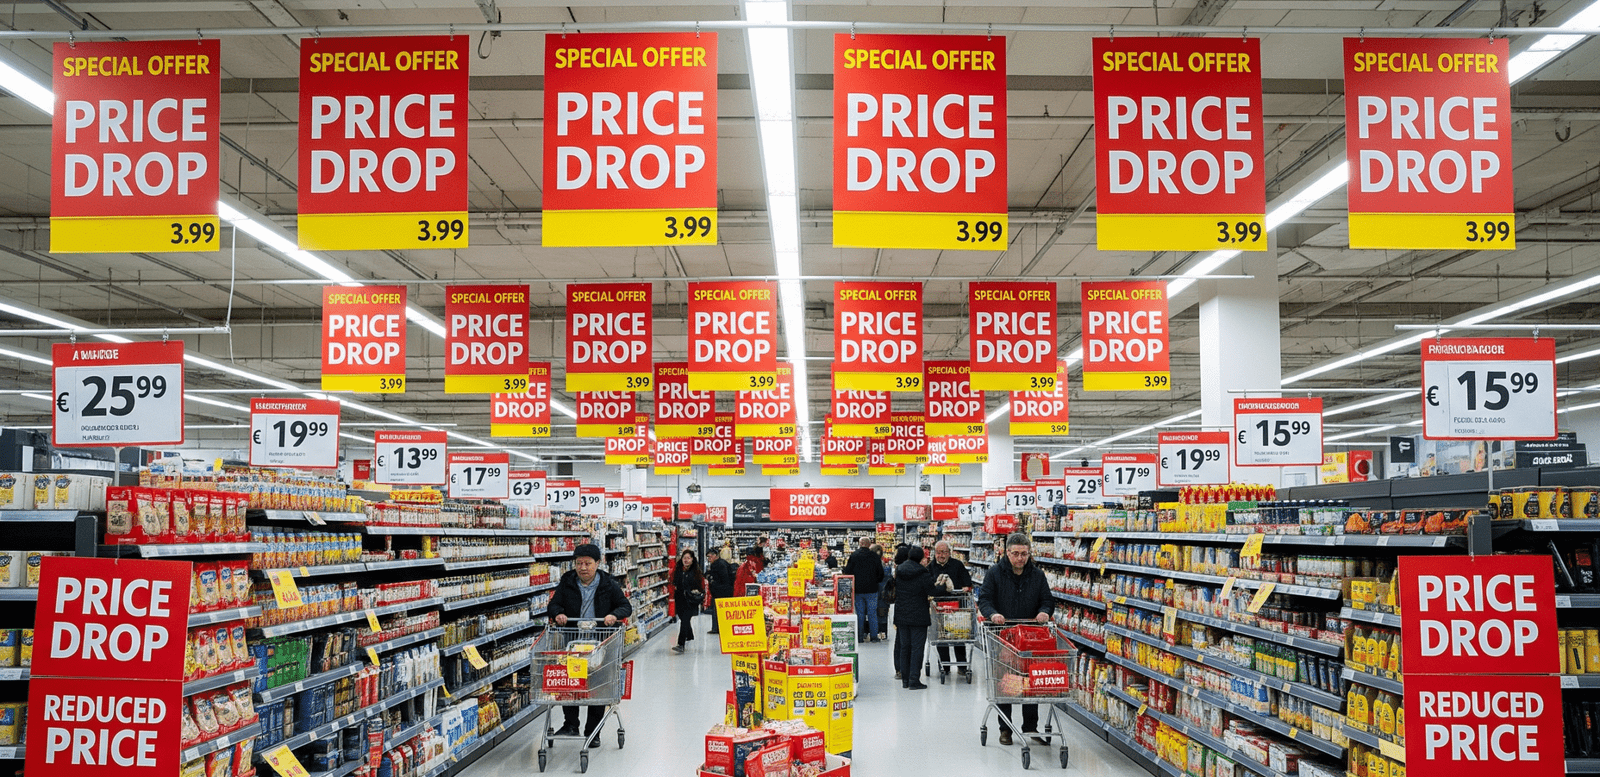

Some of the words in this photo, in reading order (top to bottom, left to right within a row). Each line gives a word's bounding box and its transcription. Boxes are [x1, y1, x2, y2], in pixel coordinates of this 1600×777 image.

[63, 57, 143, 77] SPECIAL
[148, 55, 209, 75] OFFER
[310, 52, 390, 72] SPECIAL
[396, 51, 458, 70] OFFER
[556, 48, 637, 68] SPECIAL
[643, 47, 707, 69] OFFER
[844, 49, 927, 69] SPECIAL
[932, 50, 995, 70] OFFER
[1103, 52, 1183, 71] SPECIAL
[1189, 53, 1251, 72] OFFER
[1354, 52, 1433, 72] SPECIAL
[1438, 53, 1499, 73] OFFER
[66, 98, 206, 143] PRICE
[312, 94, 454, 139] PRICE
[558, 91, 704, 135] PRICE
[847, 93, 994, 138] PRICE
[1108, 96, 1251, 140] PRICE
[1358, 96, 1498, 140] PRICE
[65, 152, 207, 196] DROP
[311, 148, 455, 193] DROP
[557, 145, 705, 189] DROP
[847, 148, 995, 193] DROP
[1109, 150, 1253, 194] DROP
[1360, 150, 1500, 193] DROP
[328, 293, 369, 305] SPECIAL
[371, 294, 401, 304] OFFER
[452, 293, 491, 303] SPECIAL
[494, 293, 524, 303] OFFER
[573, 292, 614, 302] SPECIAL
[617, 291, 646, 301] OFFER
[695, 290, 737, 300] SPECIAL
[739, 289, 771, 302] OFFER
[840, 290, 881, 300] SPECIAL
[885, 290, 917, 300] OFFER
[975, 290, 1015, 300] SPECIAL
[1019, 290, 1050, 301] OFFER
[1088, 290, 1129, 300] SPECIAL
[1131, 289, 1162, 300] OFFER
[329, 314, 399, 337] PRICE
[452, 314, 523, 337] PRICE
[573, 313, 645, 335] PRICE
[695, 311, 770, 335] PRICE
[841, 312, 916, 335] PRICE
[977, 312, 1051, 335] PRICE
[1089, 311, 1162, 334] PRICE
[329, 342, 399, 365] DROP
[452, 342, 523, 364] DROP
[573, 341, 646, 363] DROP
[695, 339, 770, 362] DROP
[841, 340, 916, 363] DROP
[977, 340, 1051, 363] DROP
[1090, 339, 1163, 362] DROP
[495, 402, 546, 418] DROP
[581, 403, 631, 418] DROP
[659, 403, 710, 418] DROP
[740, 402, 790, 418] DROP
[836, 402, 886, 418] DROP
[930, 401, 980, 417] DROP
[1014, 401, 1064, 416] DROP
[608, 439, 645, 451] DROP
[657, 442, 687, 451] PRICE
[695, 439, 731, 451] DROP
[756, 439, 792, 451] DROP
[828, 440, 863, 451] DROP
[888, 439, 924, 450] DROP
[948, 438, 985, 450] DROP
[657, 453, 688, 463] DROP
[55, 577, 172, 617] PRICE
[1418, 575, 1536, 611] PRICE
[51, 622, 168, 661] DROP
[1420, 619, 1538, 656] DROP
[45, 695, 166, 723] REDUCED
[1420, 692, 1543, 717] REDUCED
[46, 728, 157, 766] PRICE
[1426, 724, 1539, 761] PRICE
